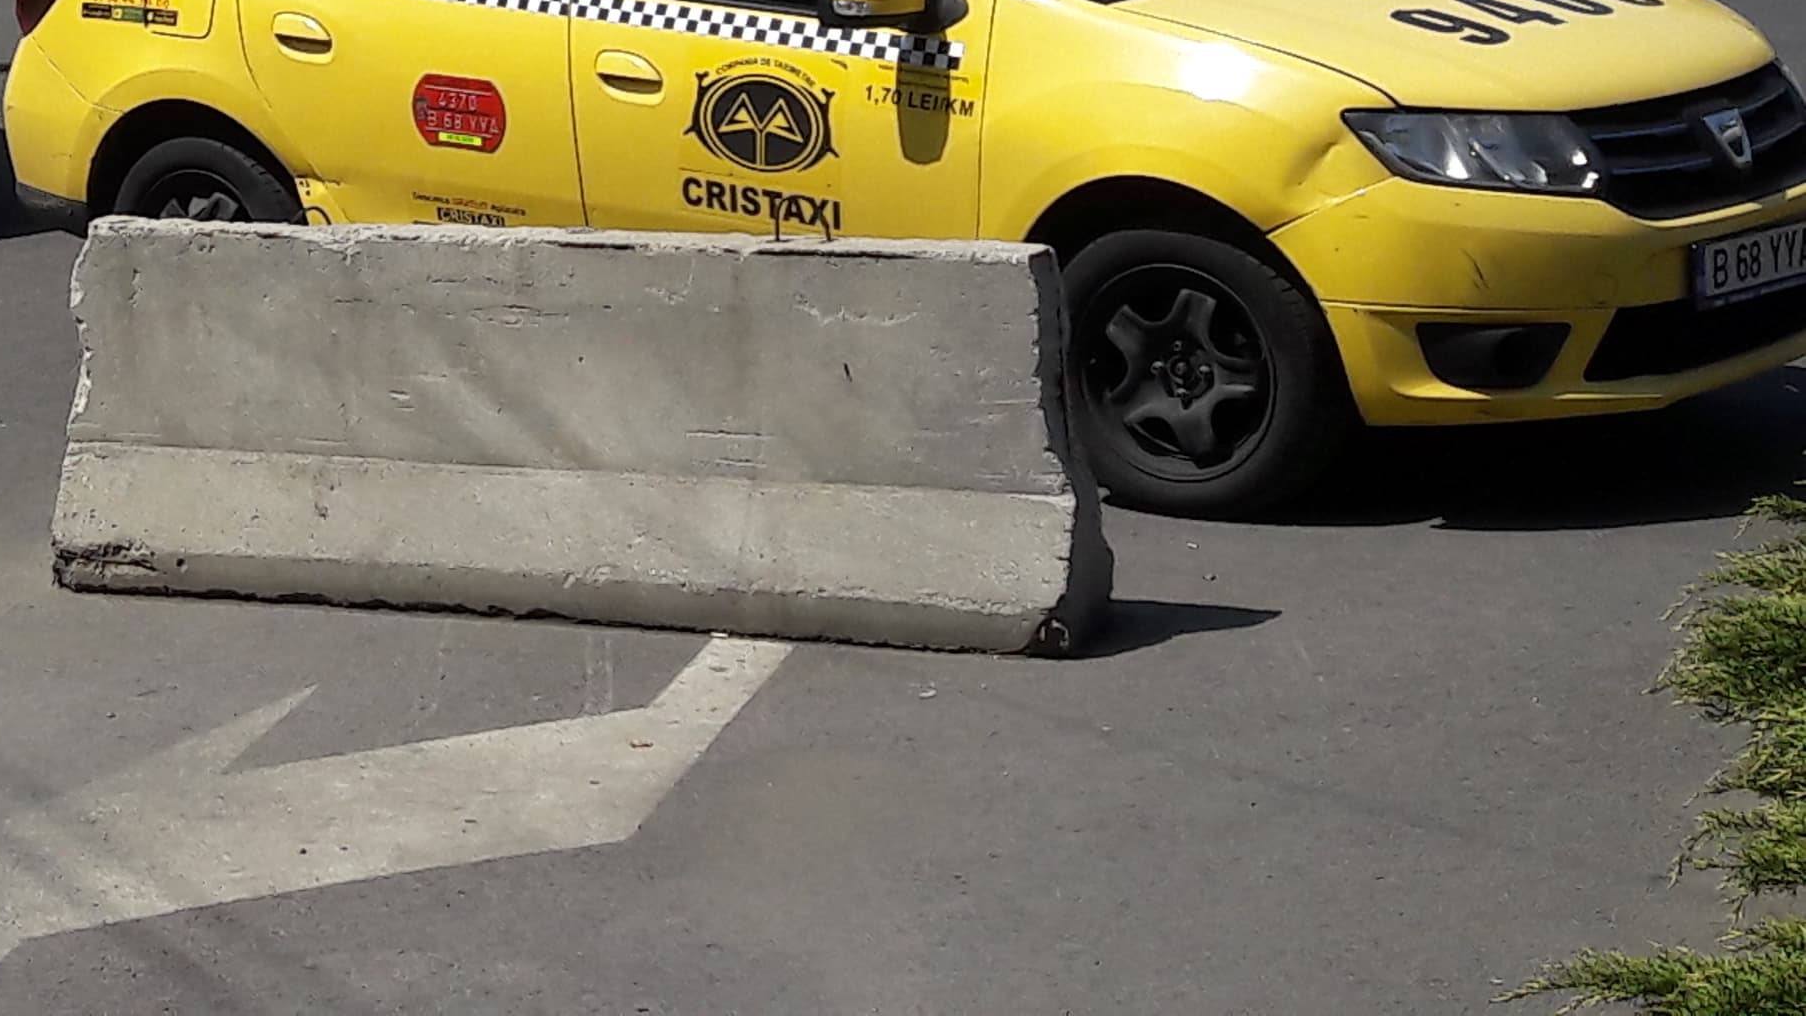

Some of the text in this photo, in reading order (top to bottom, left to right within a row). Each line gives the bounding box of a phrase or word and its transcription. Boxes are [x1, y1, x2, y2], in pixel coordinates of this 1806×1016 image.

[866, 84, 902, 105] 1,70
[440, 207, 505, 226] CRISTAXI
[682, 176, 841, 230] CRISTAXI
[1713, 248, 1729, 290] B
[1737, 240, 1762, 281] 68
